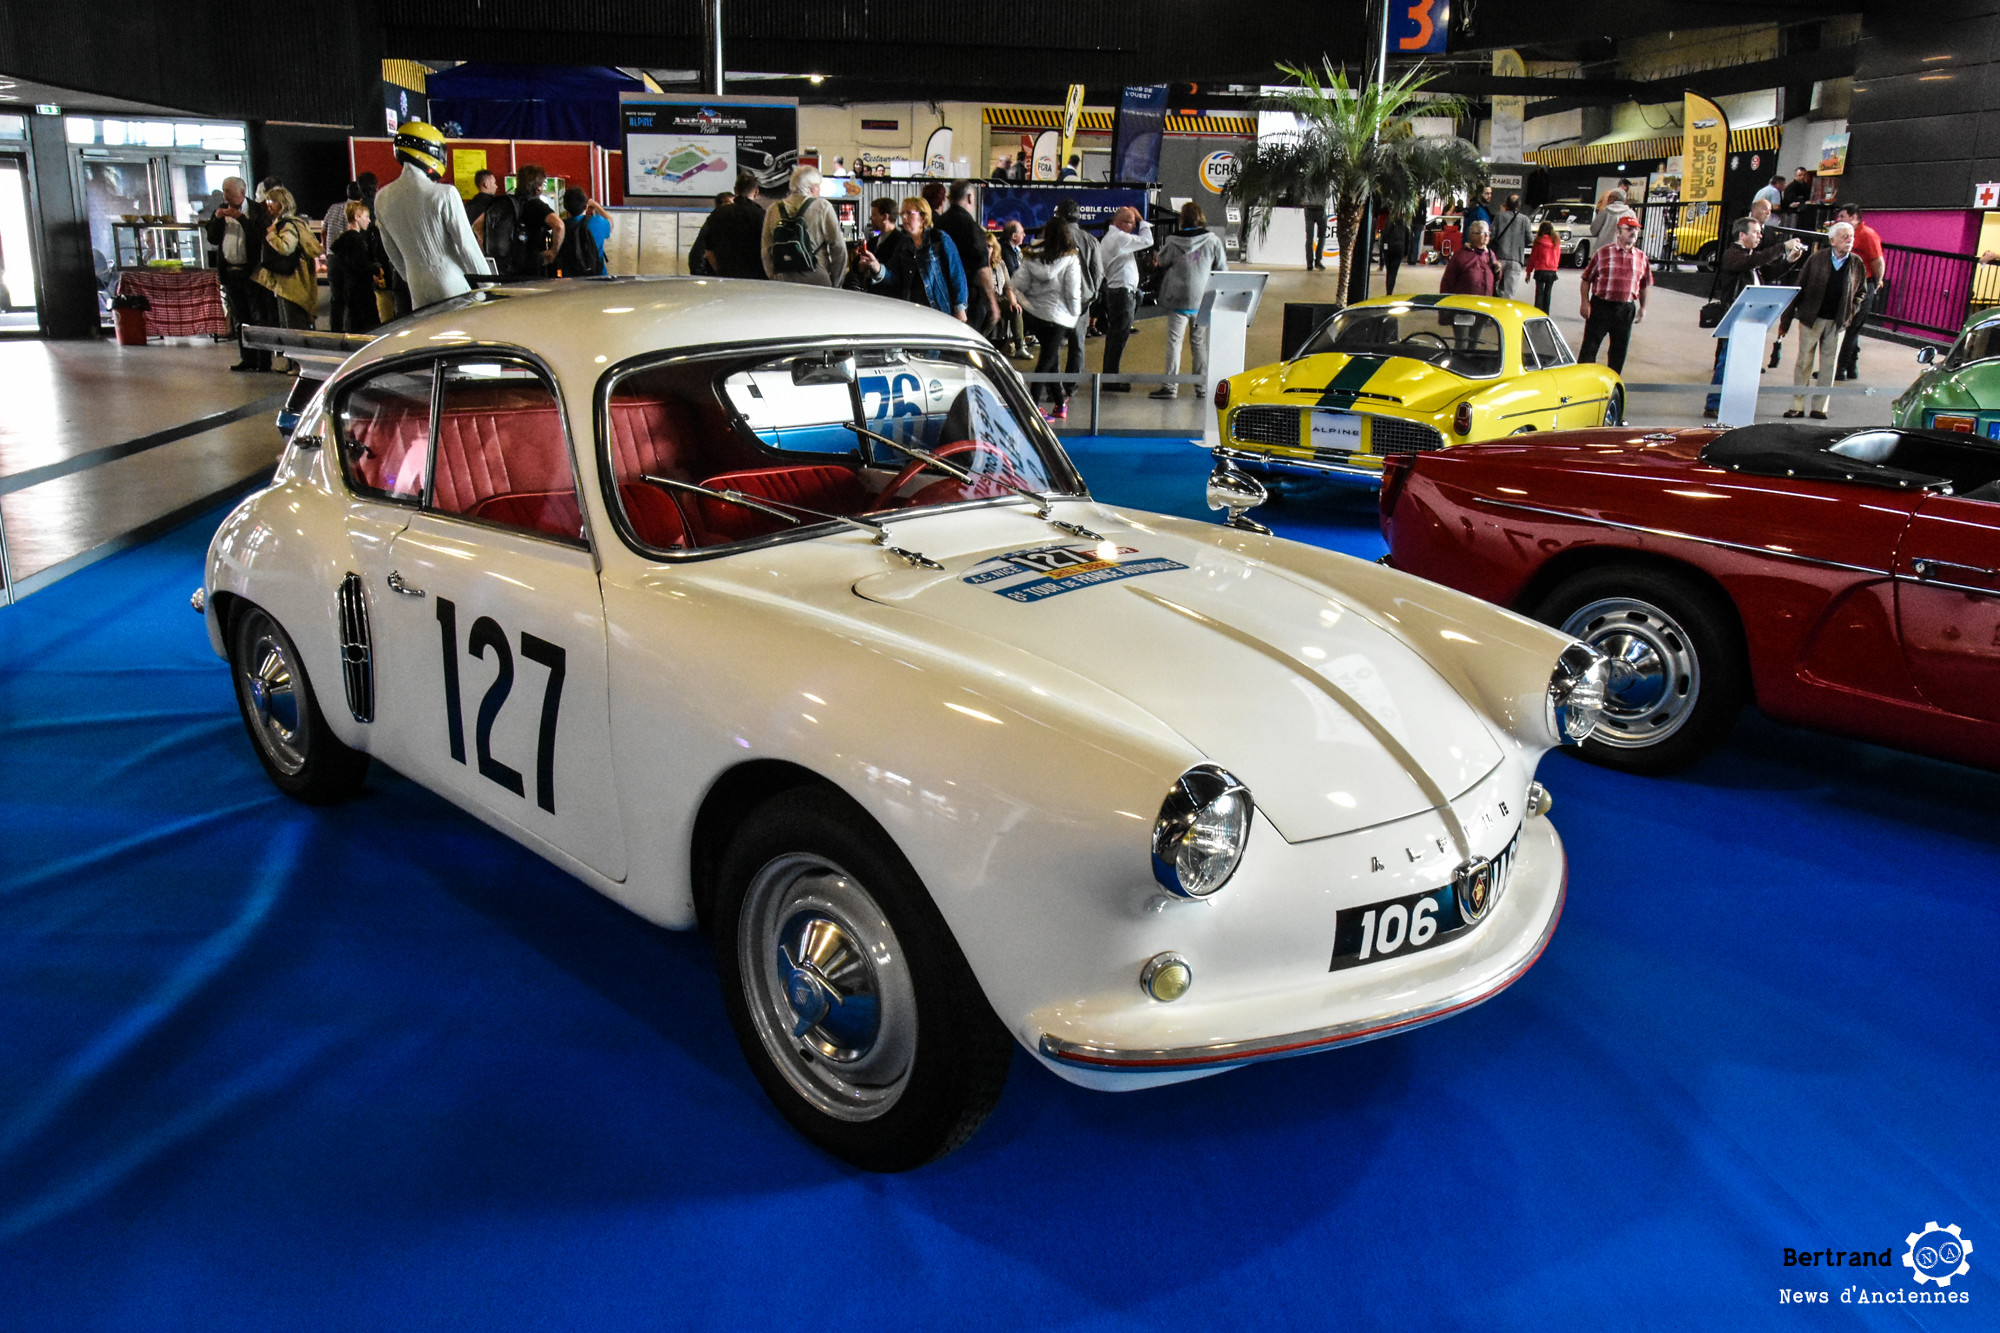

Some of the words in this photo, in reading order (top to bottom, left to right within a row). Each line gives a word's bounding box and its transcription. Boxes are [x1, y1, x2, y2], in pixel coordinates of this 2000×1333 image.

[1399, 0, 1434, 50] 3
[1038, 162, 1052, 173] FCRA
[1312, 427, 1360, 436] ALPINE
[1008, 548, 1090, 573] 127
[1022, 582, 1066, 597] TOUR
[1061, 579, 1081, 588] DE
[1071, 567, 1124, 585] FRANCE
[1118, 560, 1184, 576] AUTOMOBILE
[436, 596, 566, 815] 127
[1359, 897, 1439, 960] 106
